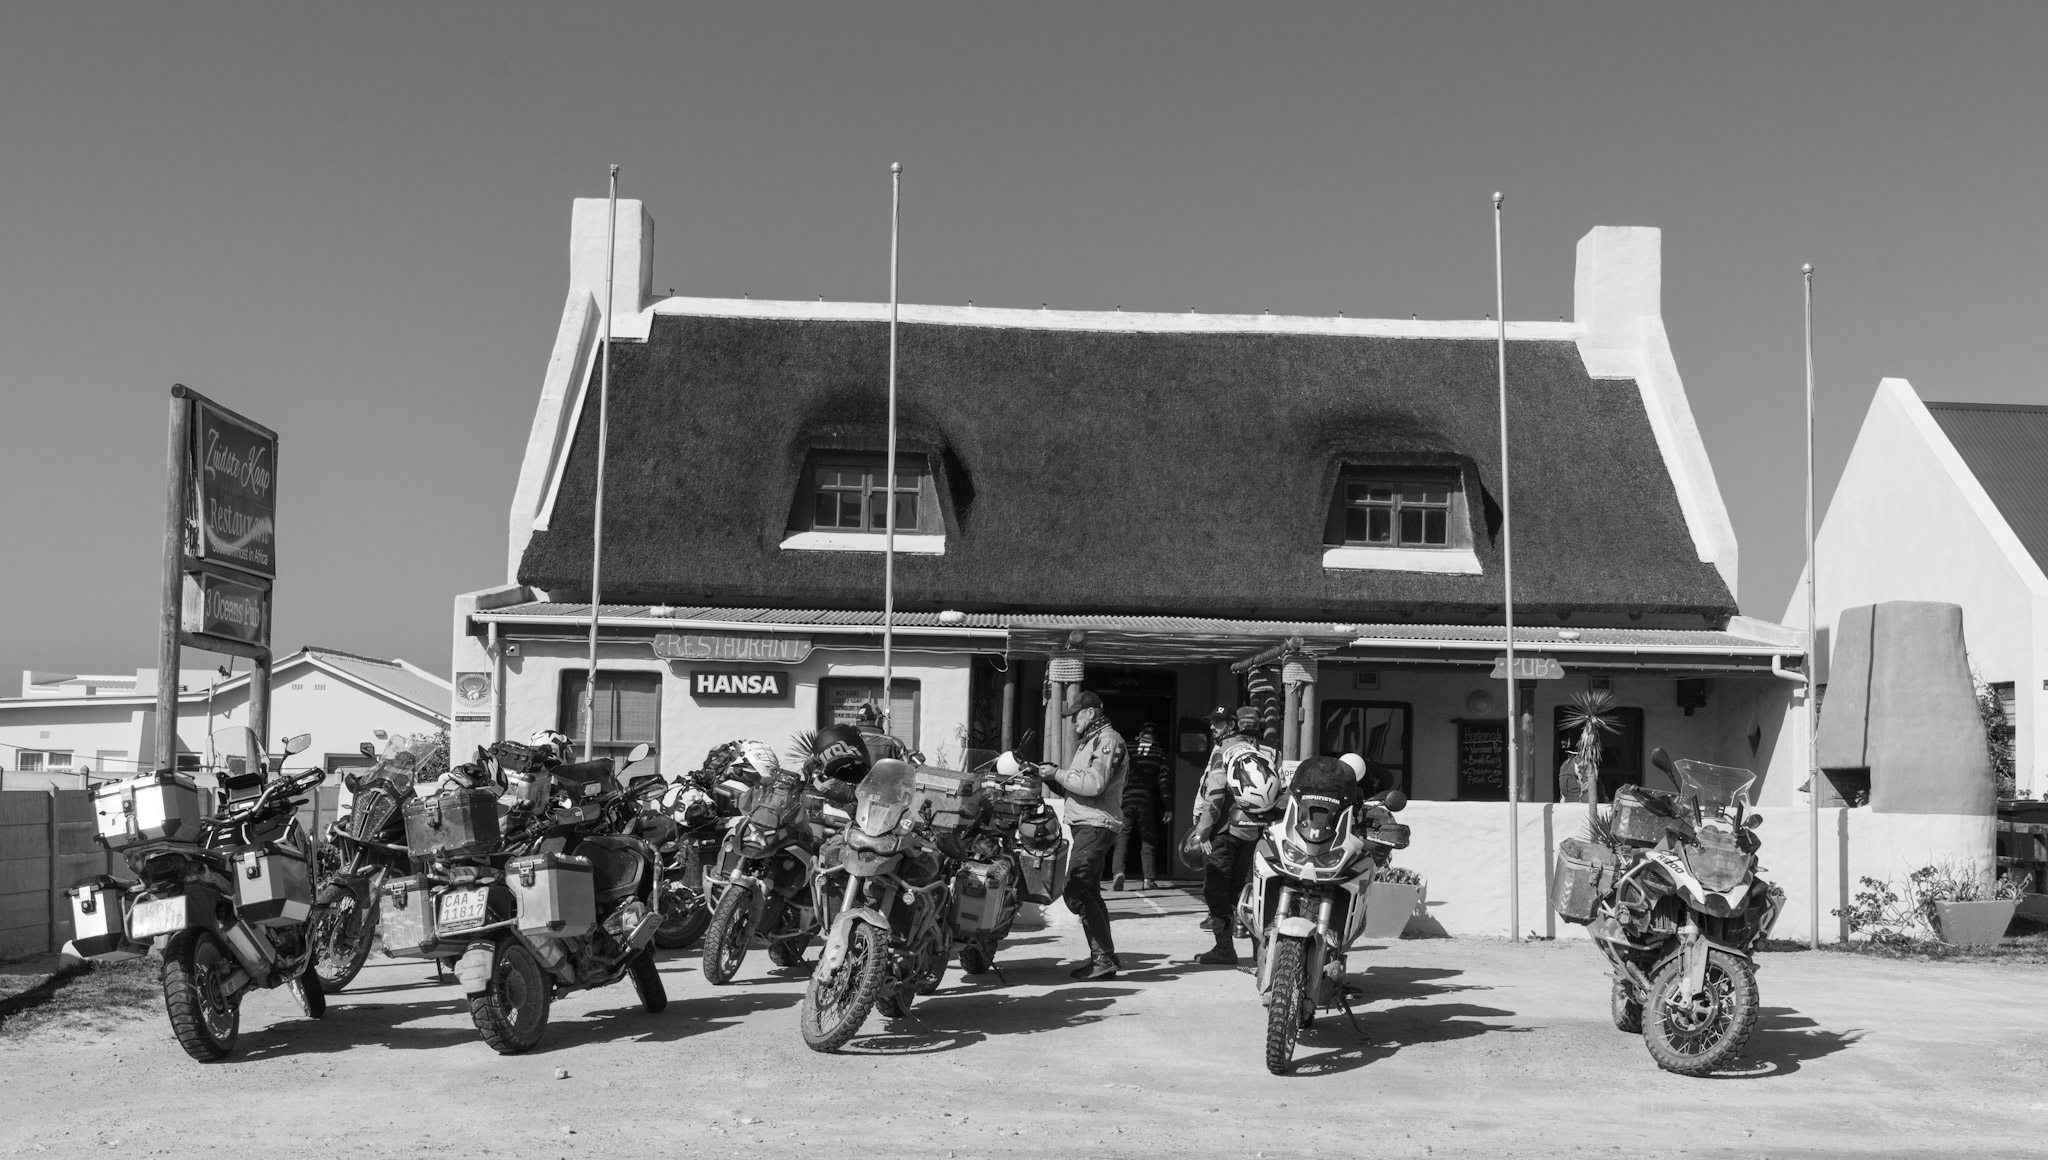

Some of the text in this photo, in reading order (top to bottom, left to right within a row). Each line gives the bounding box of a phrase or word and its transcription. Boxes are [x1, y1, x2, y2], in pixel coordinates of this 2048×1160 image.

[204, 428, 270, 497] Zuidste Kaap
[210, 498, 269, 544] Restaurant
[254, 548, 268, 565] Africa
[206, 588, 260, 627] 3 Oceans Pub
[667, 632, 801, 659] RESTAURANT
[697, 674, 779, 695] HANSA
[1113, 678, 1140, 687] OPEN
[1284, 769, 1295, 777] OP
[1309, 827, 1320, 839] M
[445, 890, 485, 908] CAA 5
[145, 901, 175, 917] KPK
[443, 904, 483, 921] 11817
